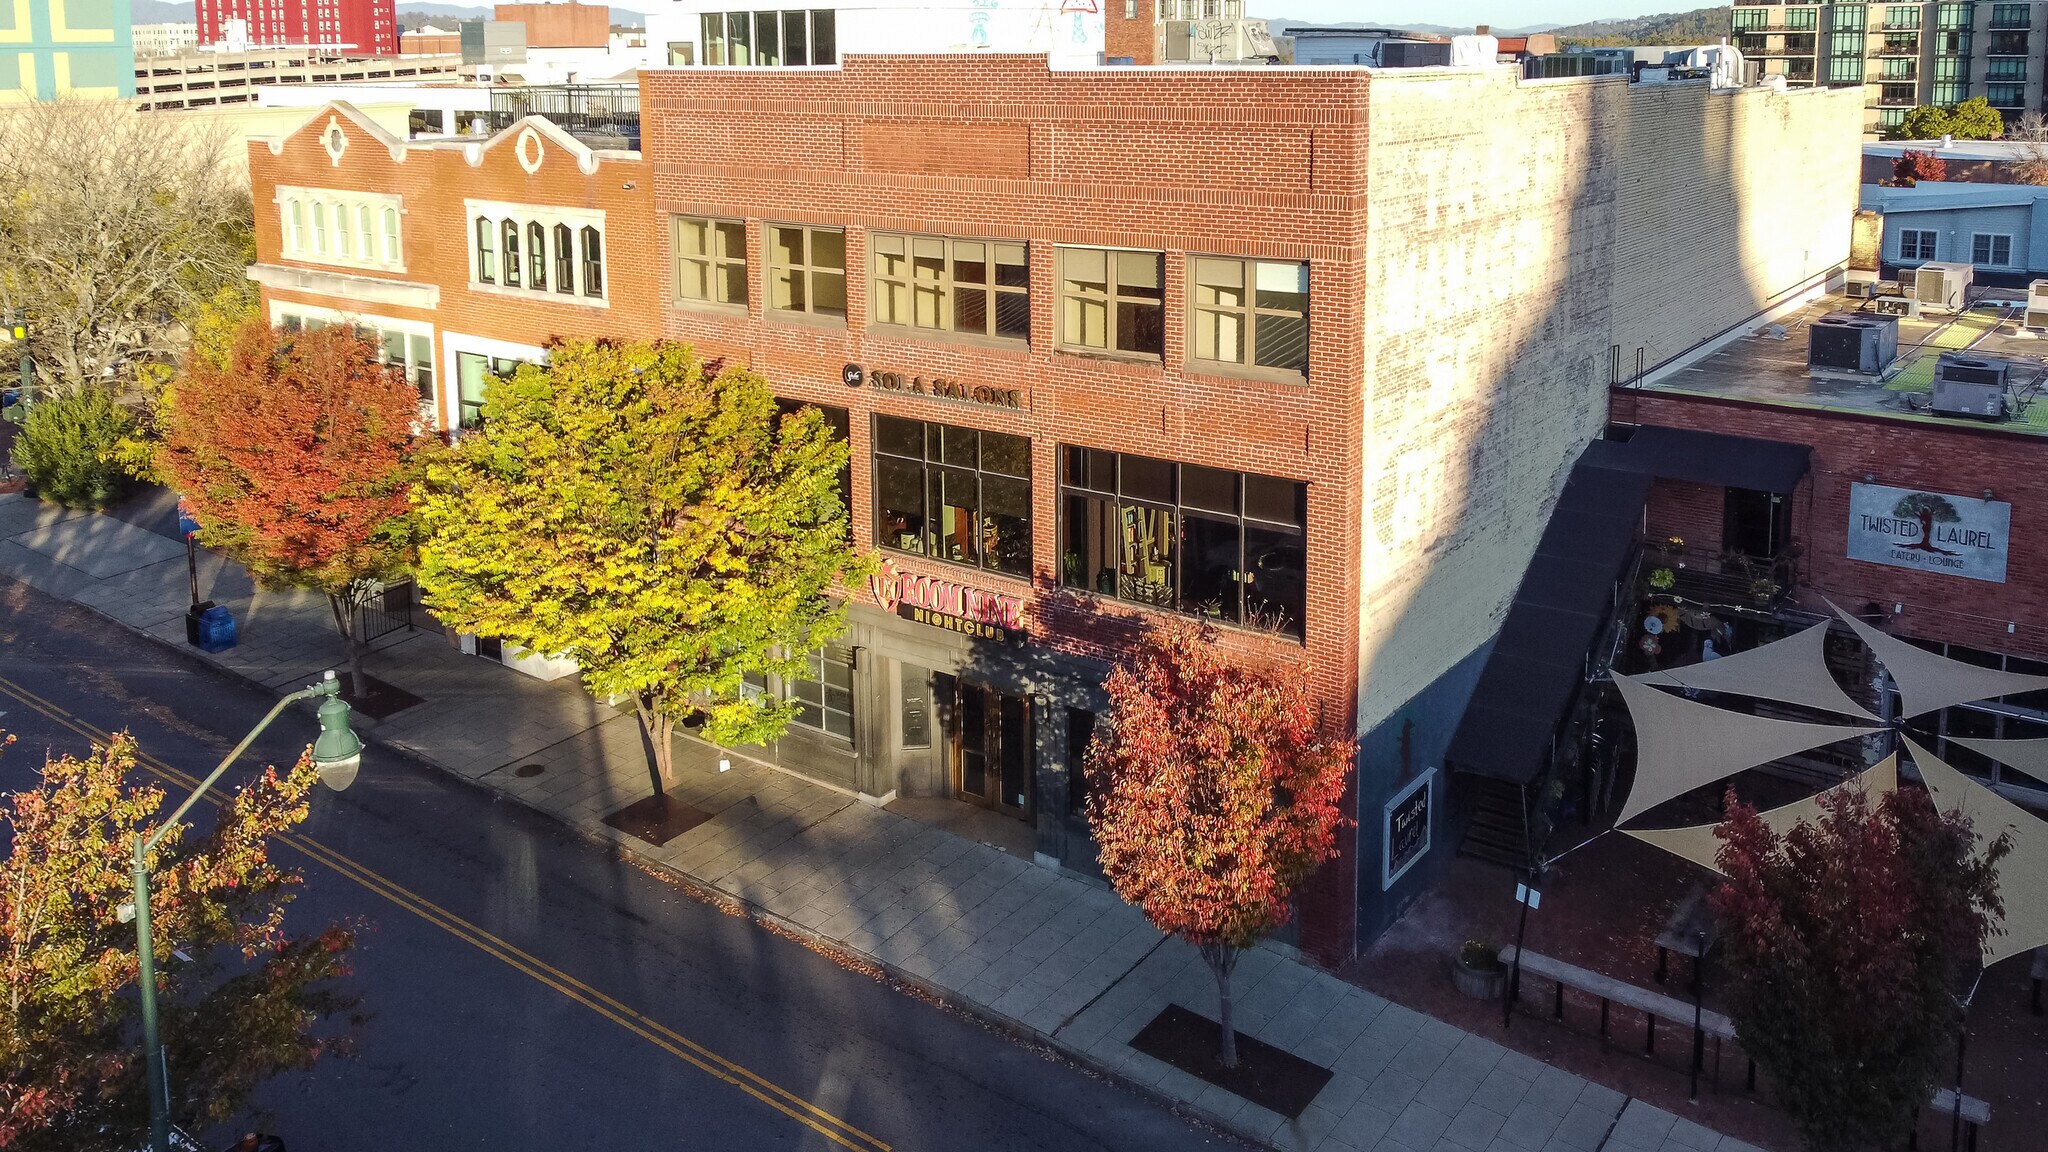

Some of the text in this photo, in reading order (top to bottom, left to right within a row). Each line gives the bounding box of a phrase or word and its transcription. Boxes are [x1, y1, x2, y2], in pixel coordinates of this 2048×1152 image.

[869, 370, 1023, 409] SOLA SALONS
[1861, 514, 1996, 550] TWISTED LAUREL
[1890, 549, 1965, 569] EATERY LOUNGE
[901, 572, 1023, 630] ROOM NINE
[914, 607, 1005, 642] NIGHTCLUB
[1396, 791, 1426, 833] Twisted
